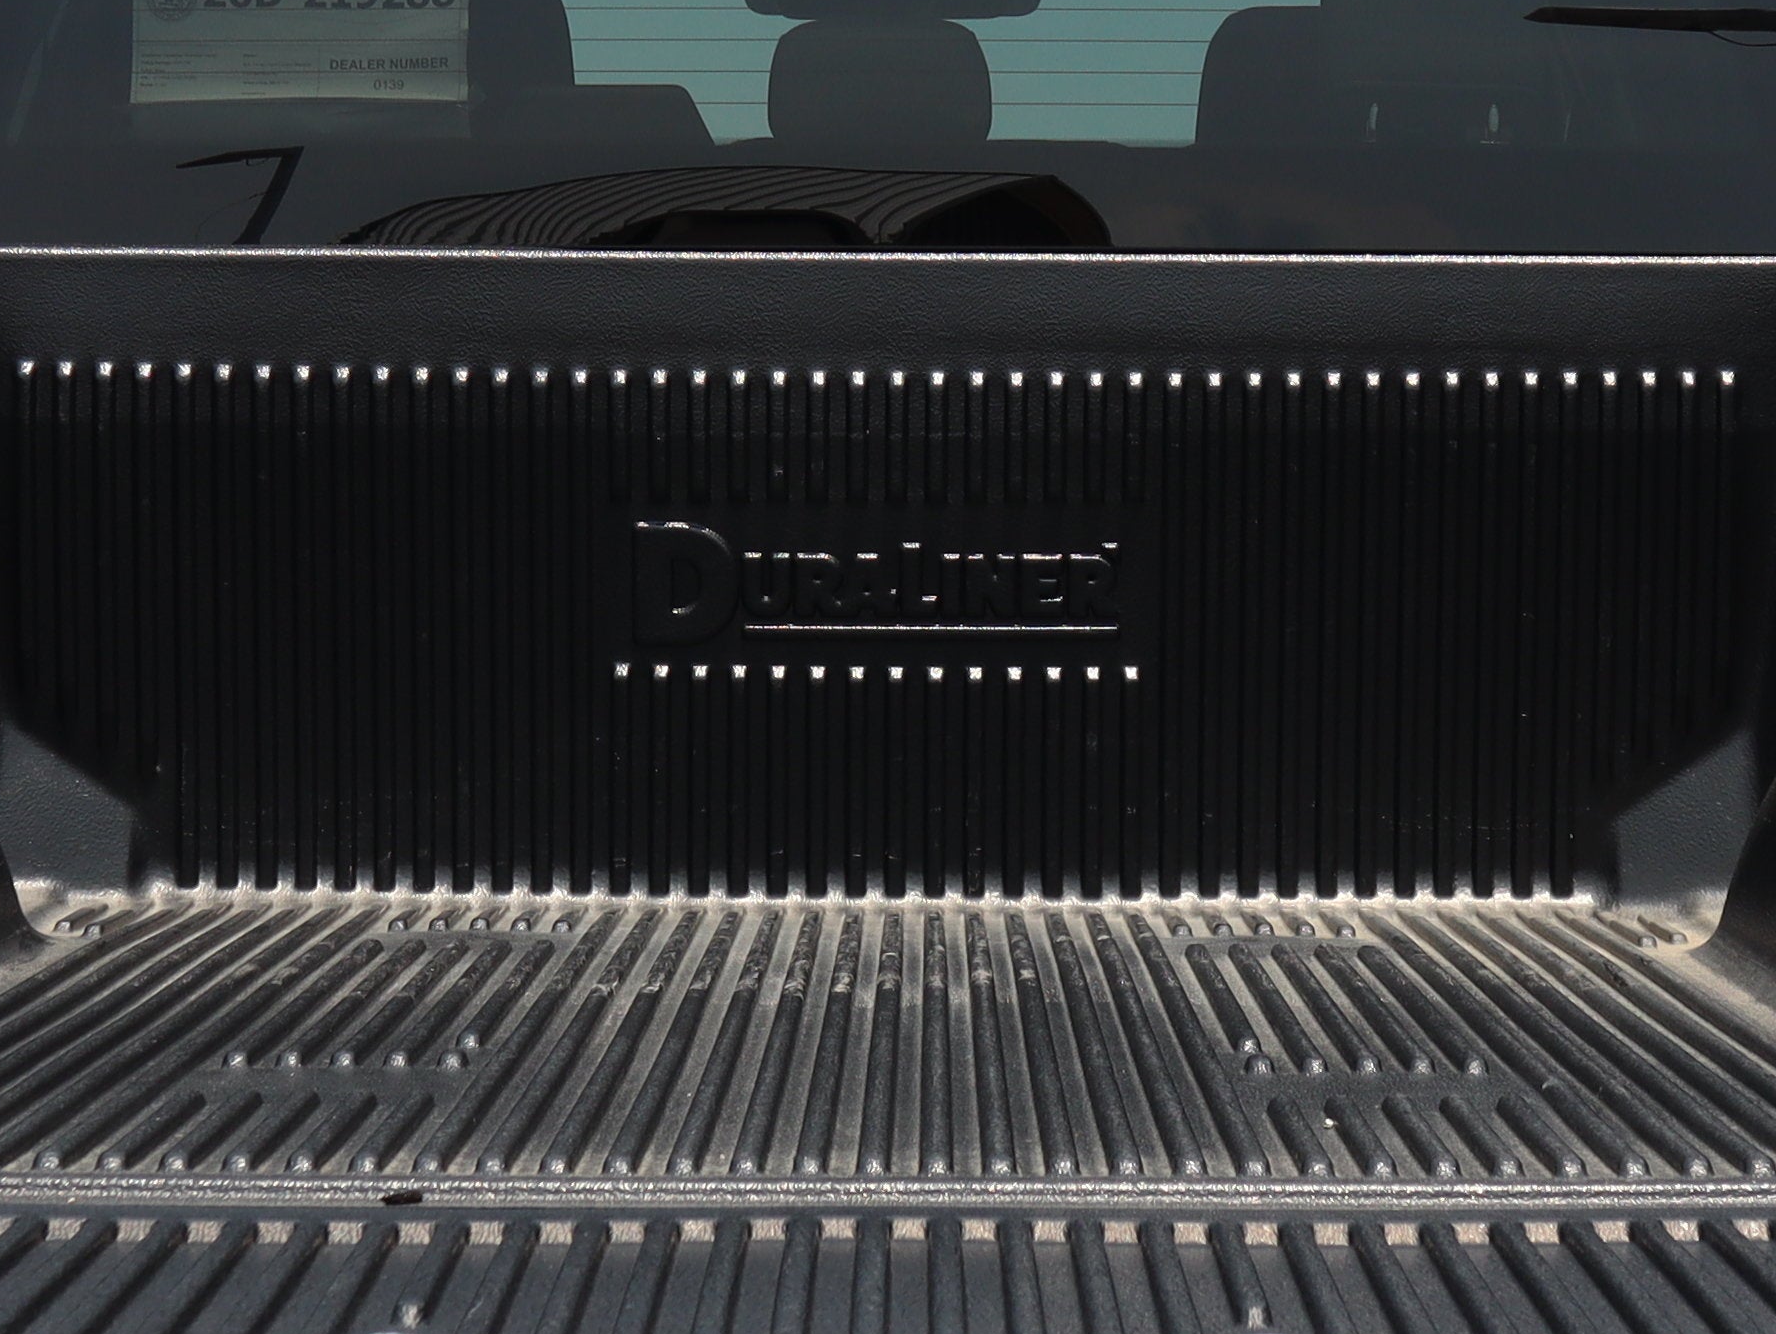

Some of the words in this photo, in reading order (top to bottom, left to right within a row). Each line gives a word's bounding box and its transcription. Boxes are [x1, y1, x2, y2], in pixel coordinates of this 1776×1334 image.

[329, 58, 386, 71] DEALER
[389, 56, 449, 70] NUMBER
[373, 78, 405, 91] 0139
